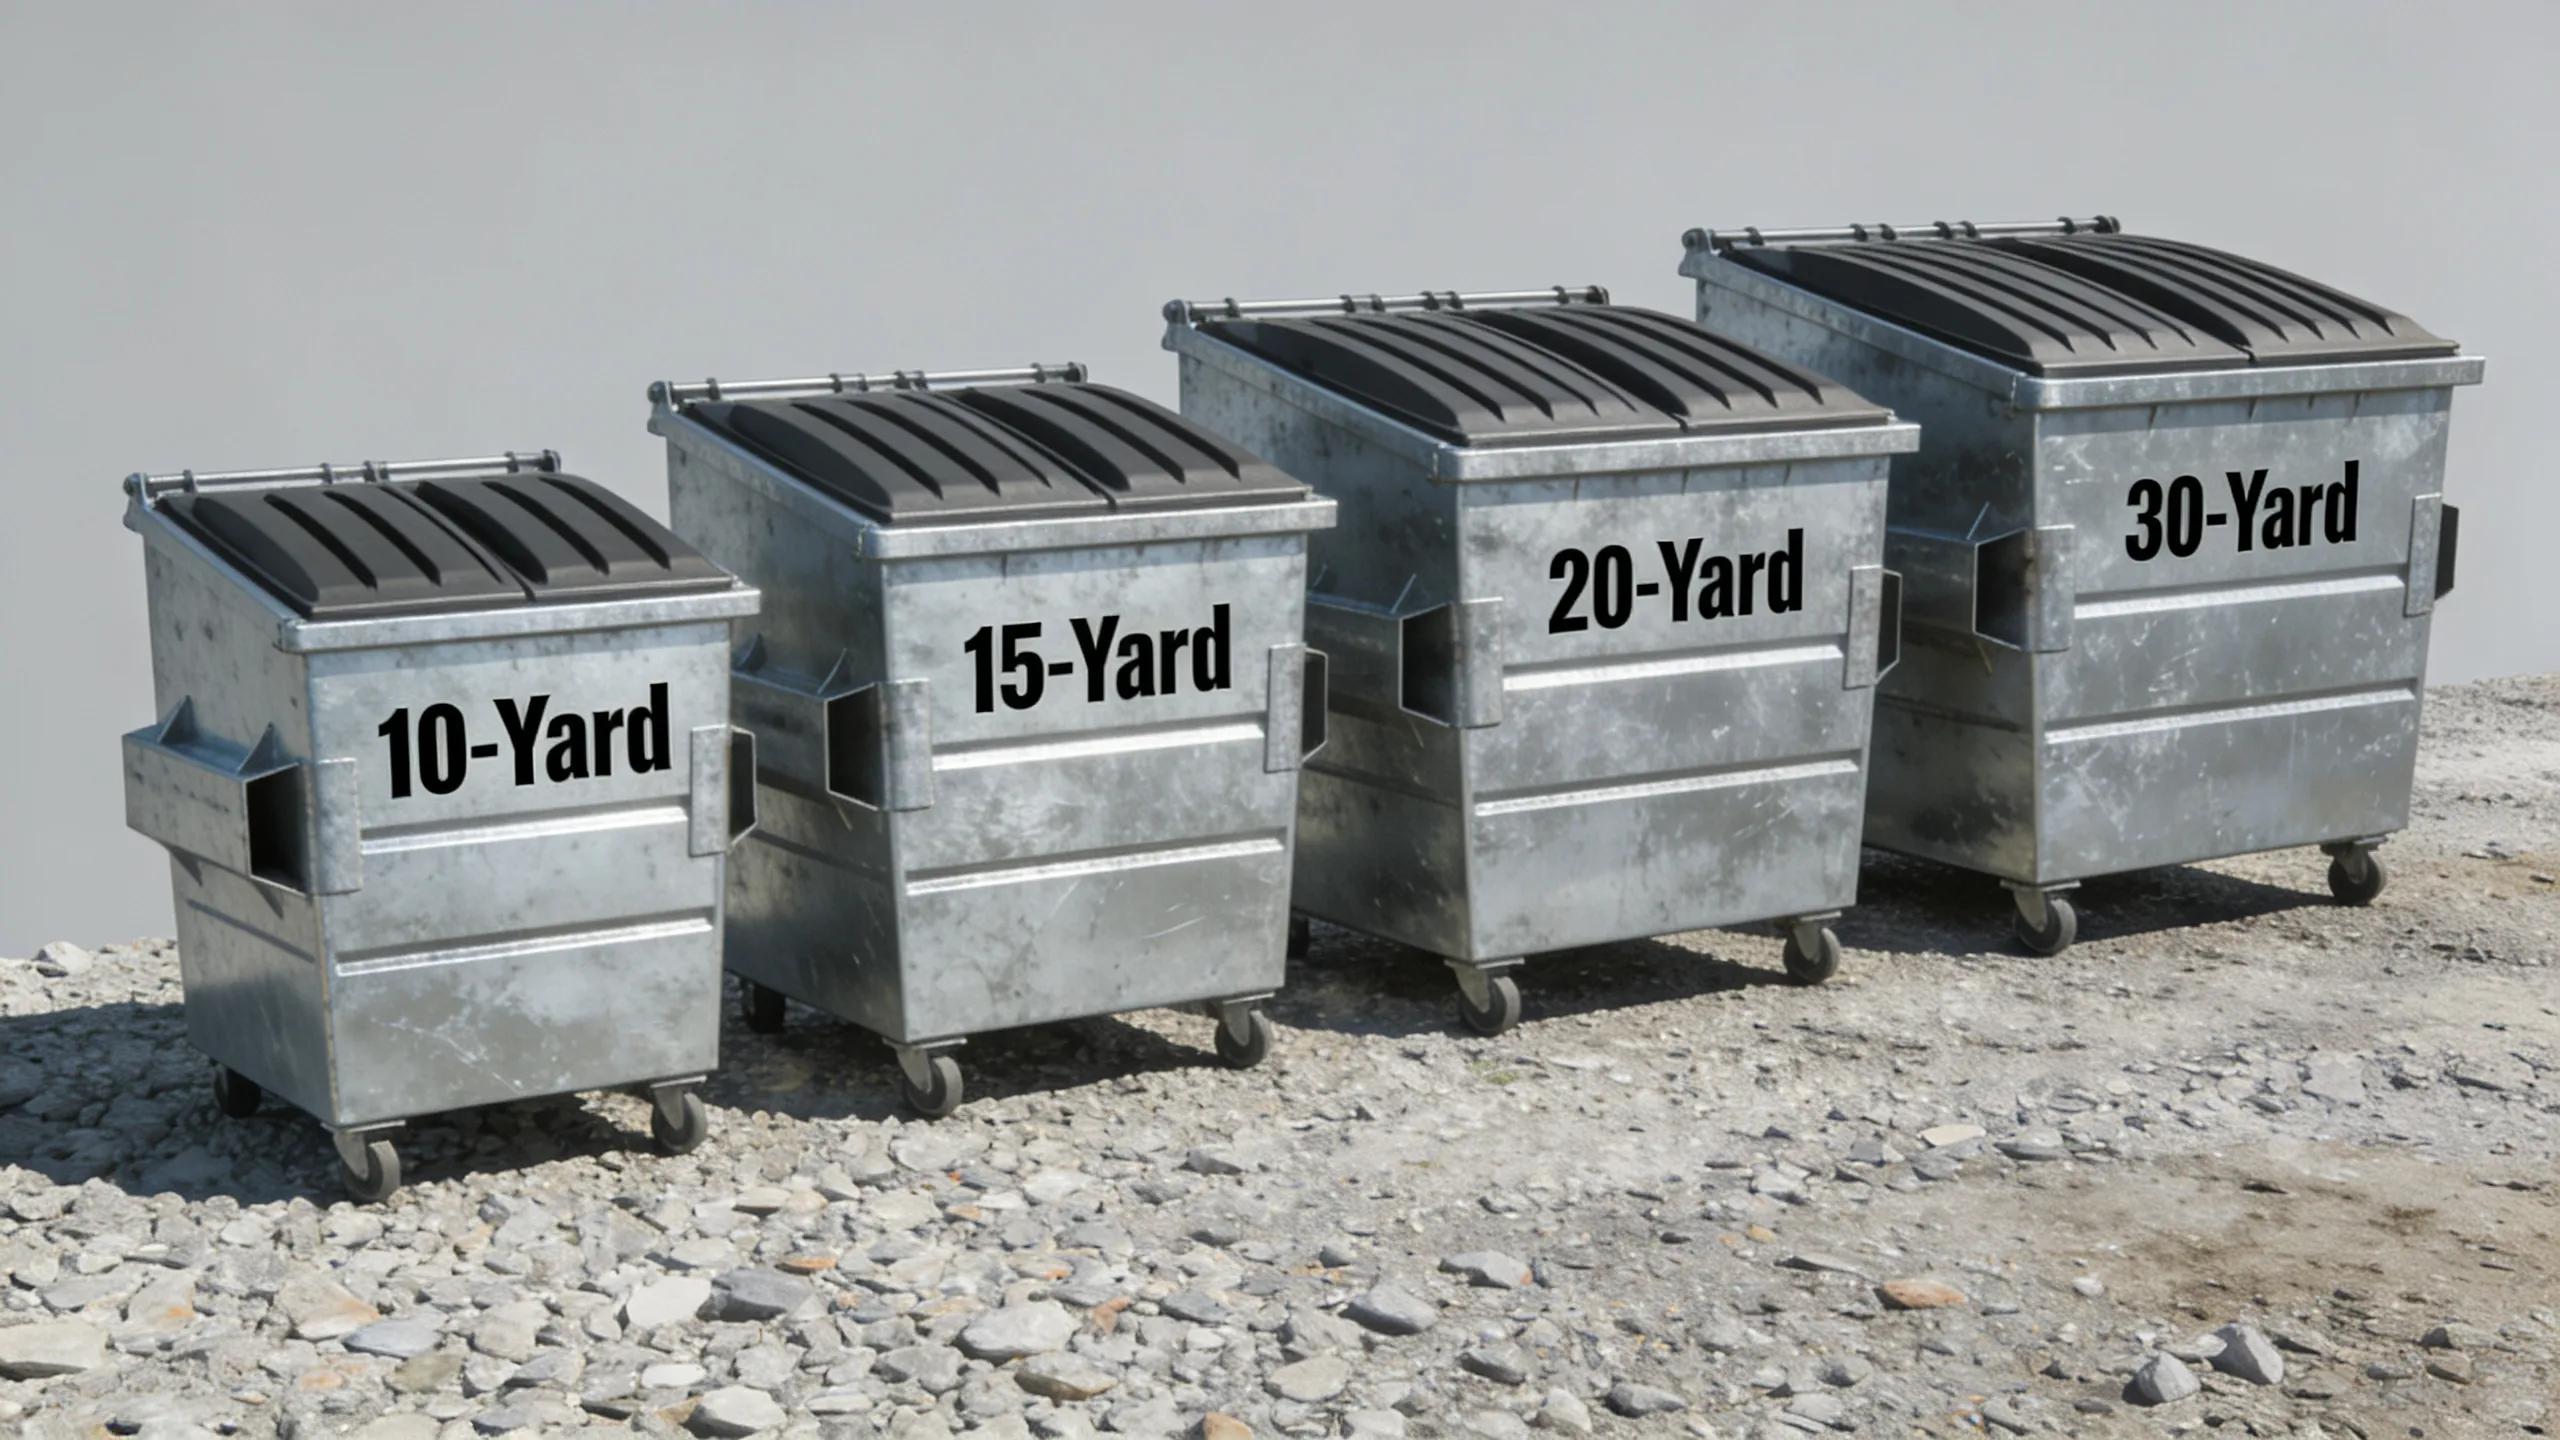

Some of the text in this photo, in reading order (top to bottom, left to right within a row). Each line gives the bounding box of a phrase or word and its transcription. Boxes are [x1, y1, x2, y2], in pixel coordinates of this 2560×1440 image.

[2125, 459, 2360, 564] 30-Yard
[1548, 528, 1804, 634] 20-Yard
[964, 603, 1231, 713] 15-Yard
[378, 682, 671, 799] 10-Yard
